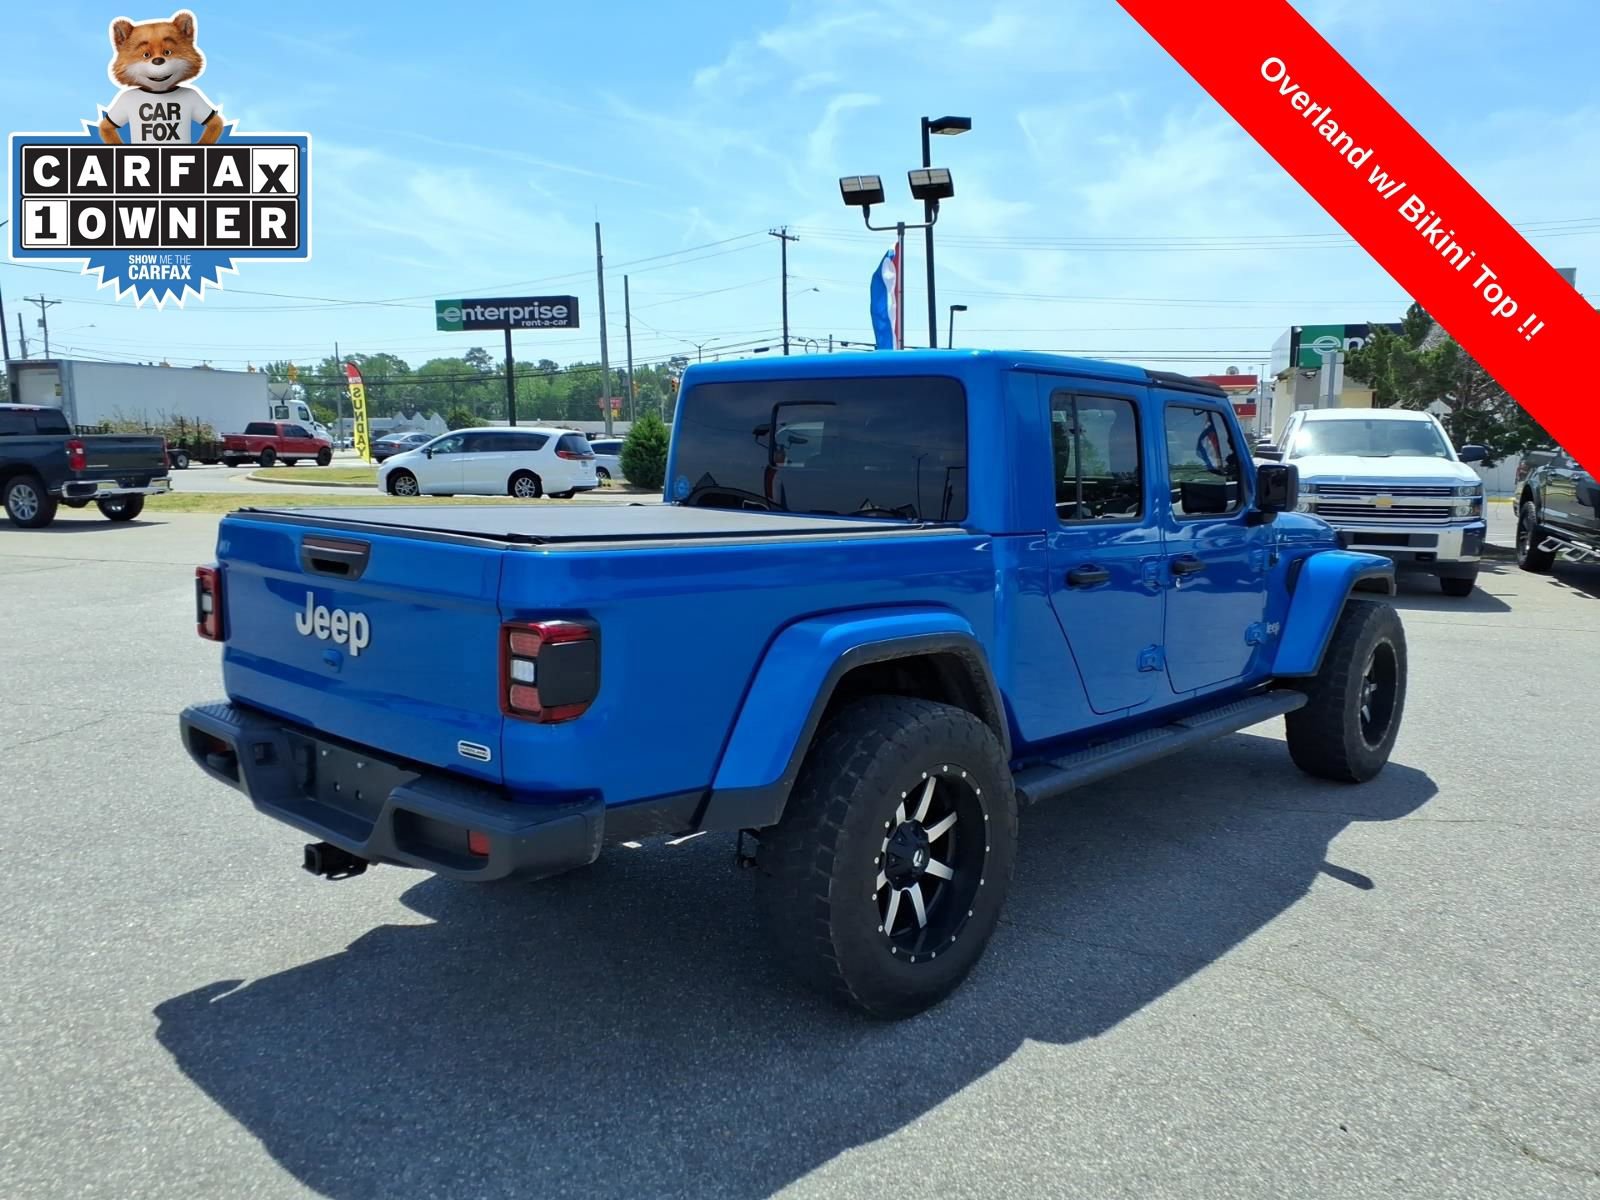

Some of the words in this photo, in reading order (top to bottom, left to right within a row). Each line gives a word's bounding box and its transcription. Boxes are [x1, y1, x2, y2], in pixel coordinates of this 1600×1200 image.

[438, 302, 568, 324] enterprise
[521, 318, 568, 327] rent-a-car
[295, 591, 370, 657] Jeep
